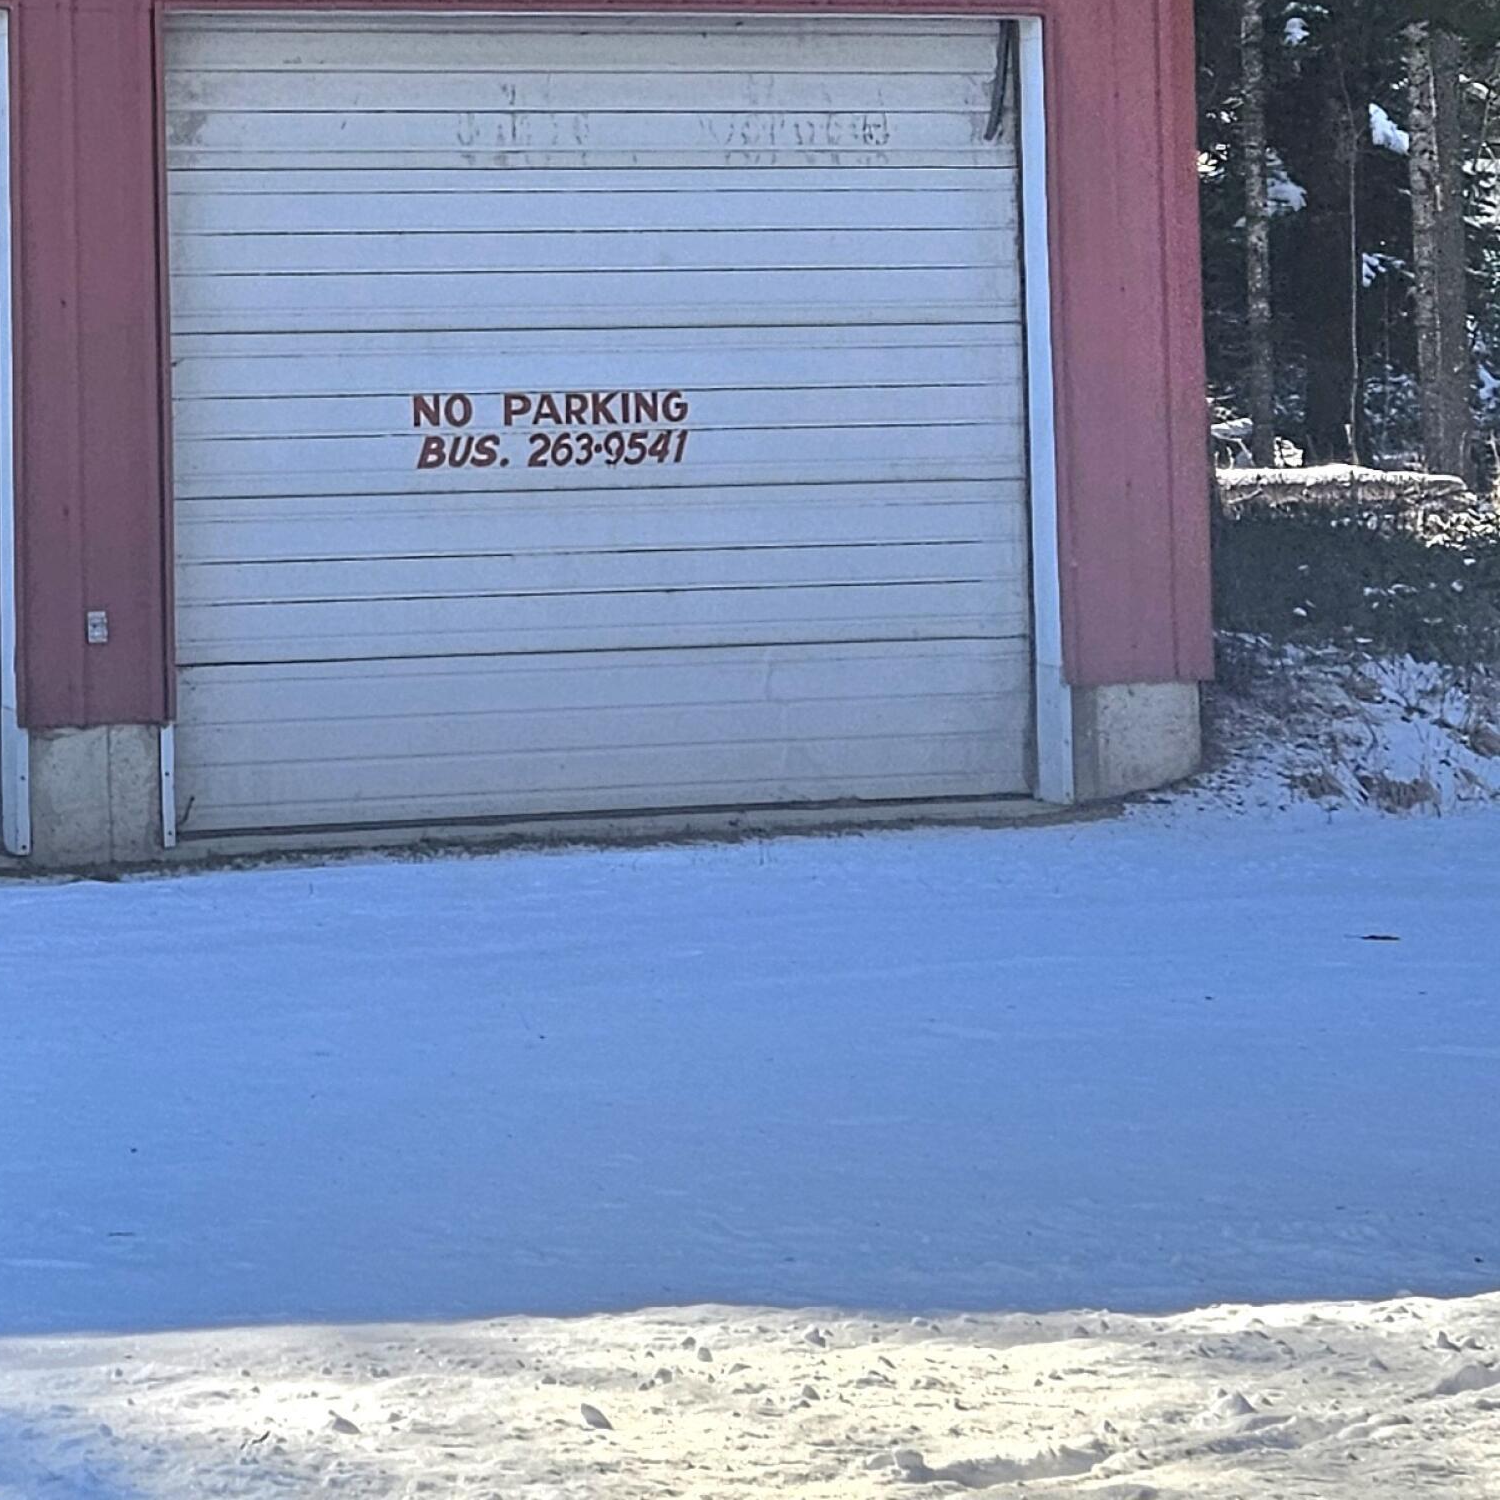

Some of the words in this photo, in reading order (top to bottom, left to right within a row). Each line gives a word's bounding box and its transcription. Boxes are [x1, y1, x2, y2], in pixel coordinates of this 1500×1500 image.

[412, 393, 473, 427] NO
[503, 390, 689, 426] PARKING
[416, 434, 510, 469] BUS.
